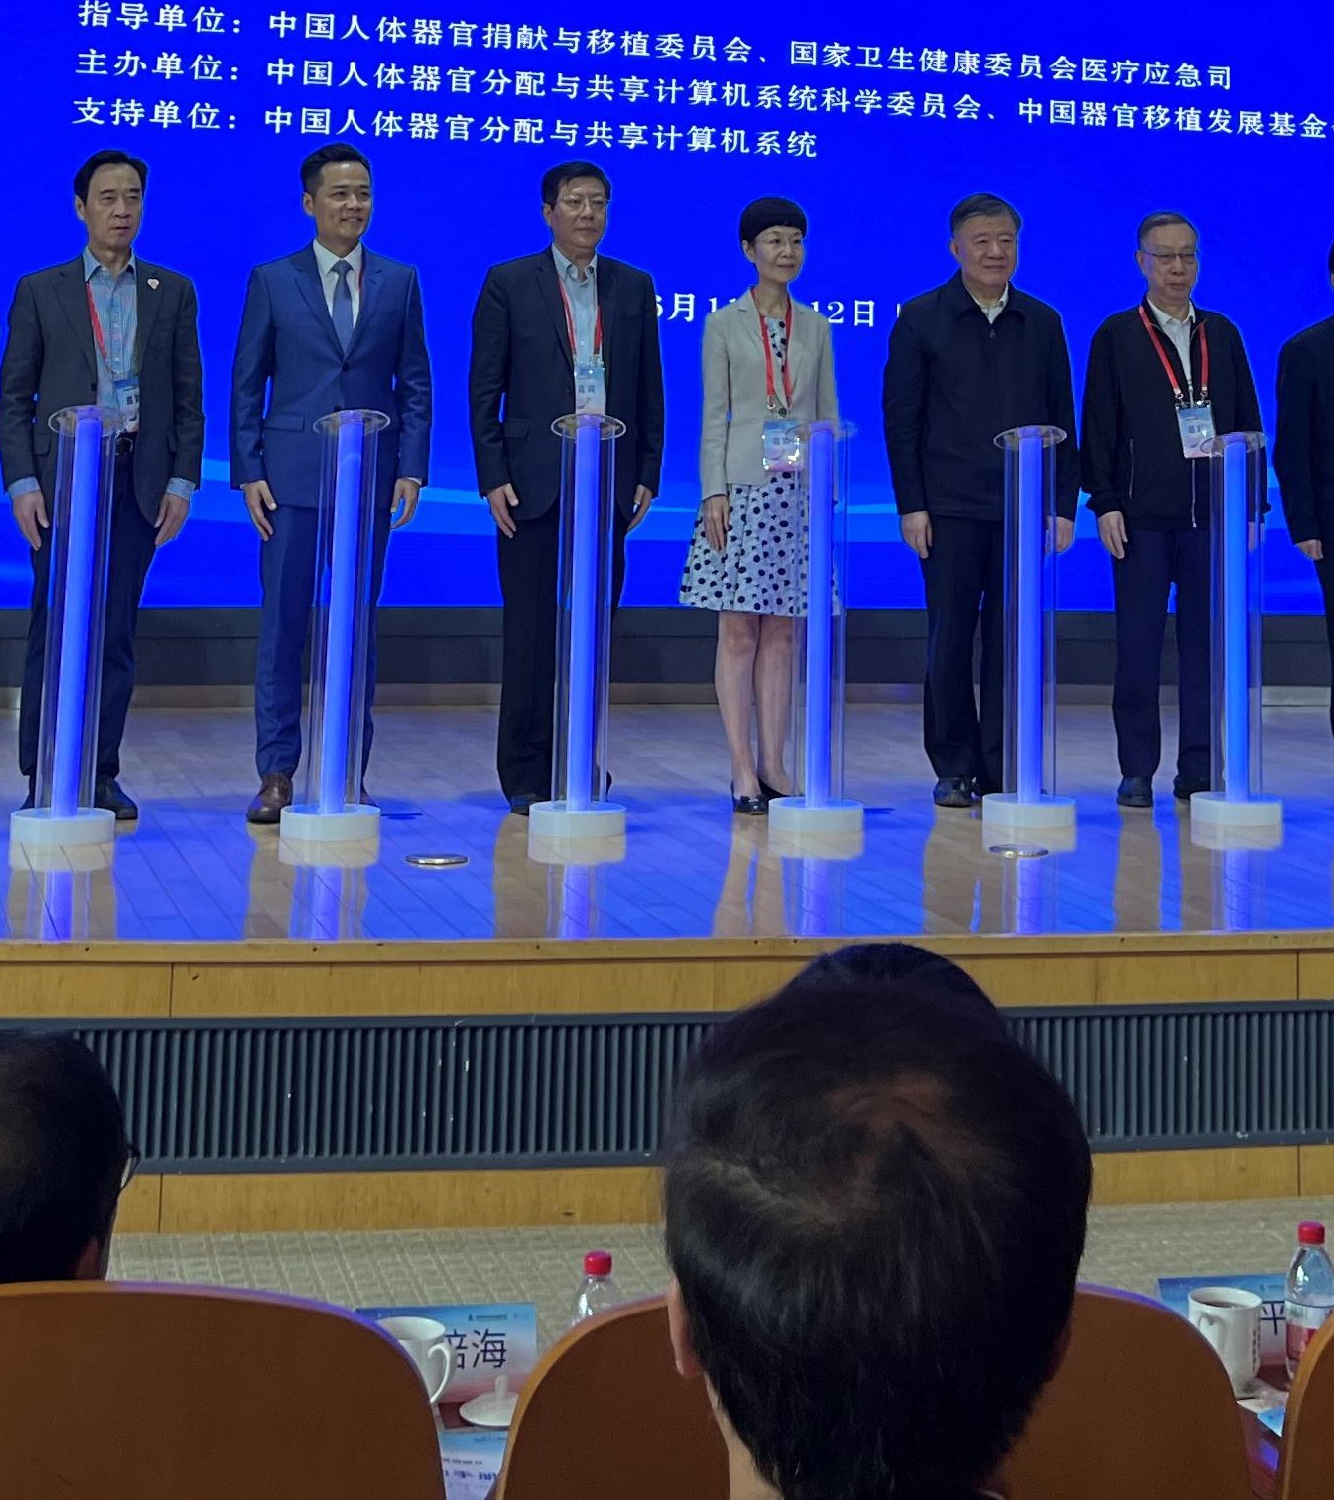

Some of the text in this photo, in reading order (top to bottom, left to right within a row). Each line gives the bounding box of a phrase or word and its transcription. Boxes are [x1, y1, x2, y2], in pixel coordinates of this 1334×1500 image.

[75, 49, 238, 81] 主办单位：
[77, 0, 1232, 90] 指导单位： 中国人体器官捐献与移植委员会、国家卫生健康委员会医疗应急司
[72, 97, 817, 158] 支持单位： 中国人体器官分配与共享计算机系统
